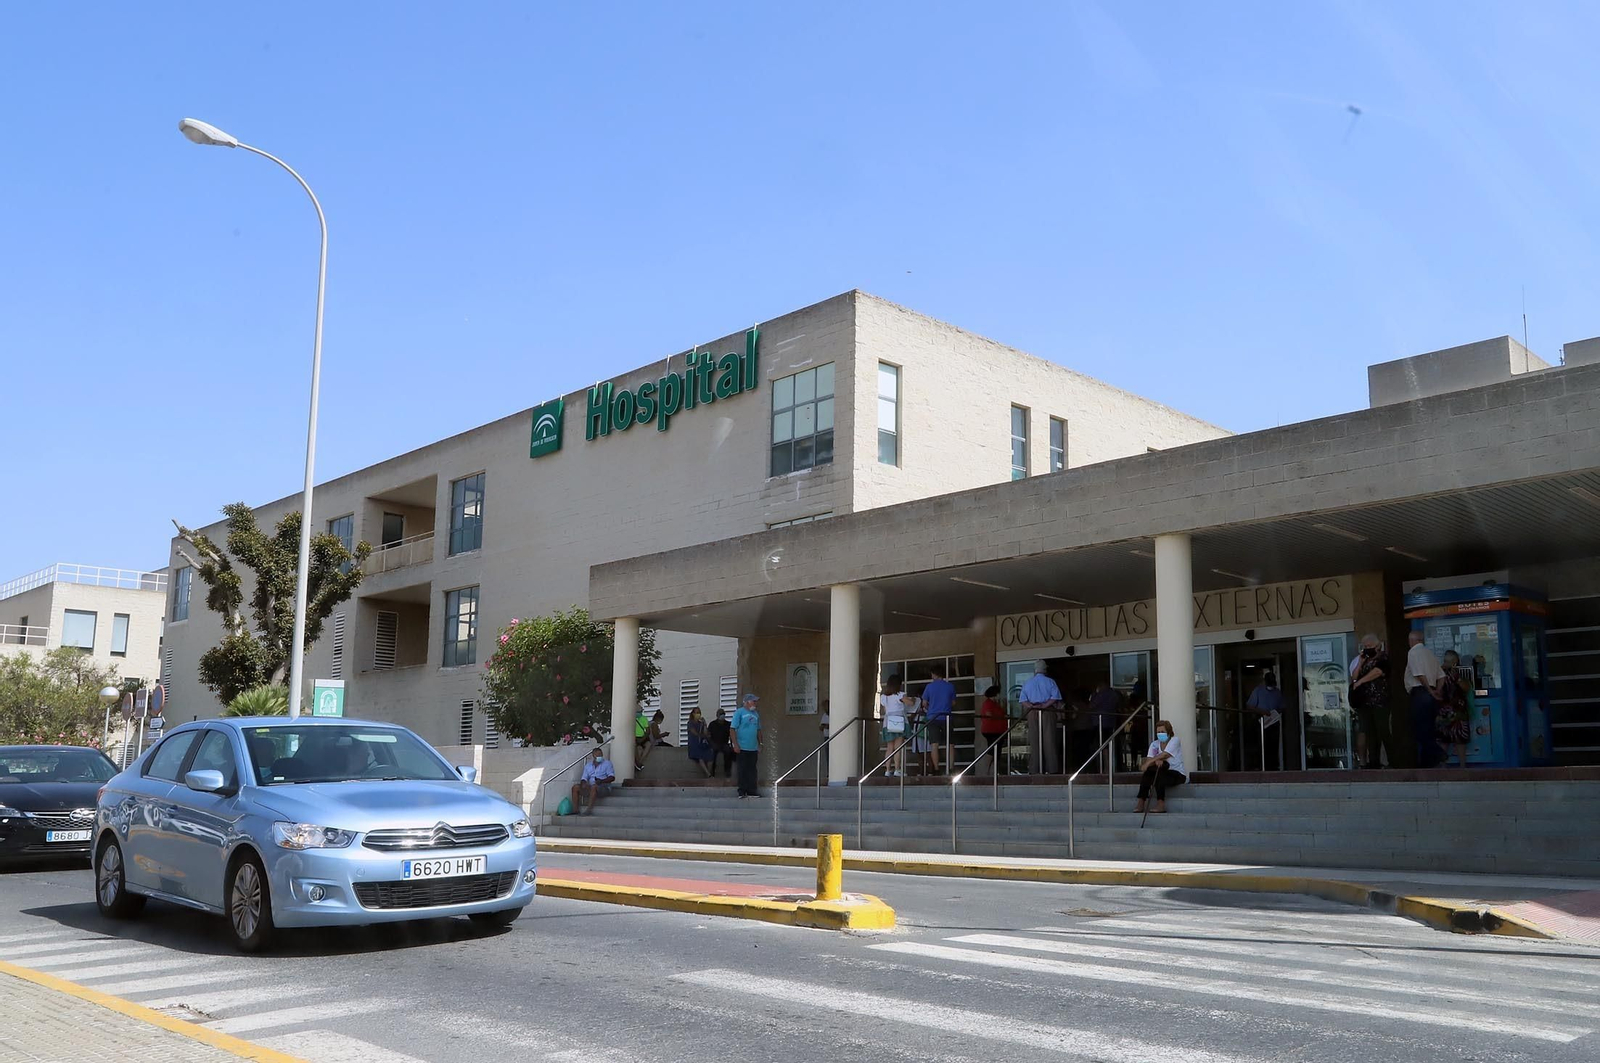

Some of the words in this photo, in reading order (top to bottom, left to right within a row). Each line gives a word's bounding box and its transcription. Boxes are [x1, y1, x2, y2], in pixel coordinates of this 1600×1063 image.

[585, 328, 759, 441] Hospital
[1000, 601, 1149, 647] CONSULTAS
[1193, 579, 1341, 629] XTERNAS
[53, 831, 80, 841] 8680
[413, 860, 451, 877] 6620
[456, 858, 482, 874] HWT
